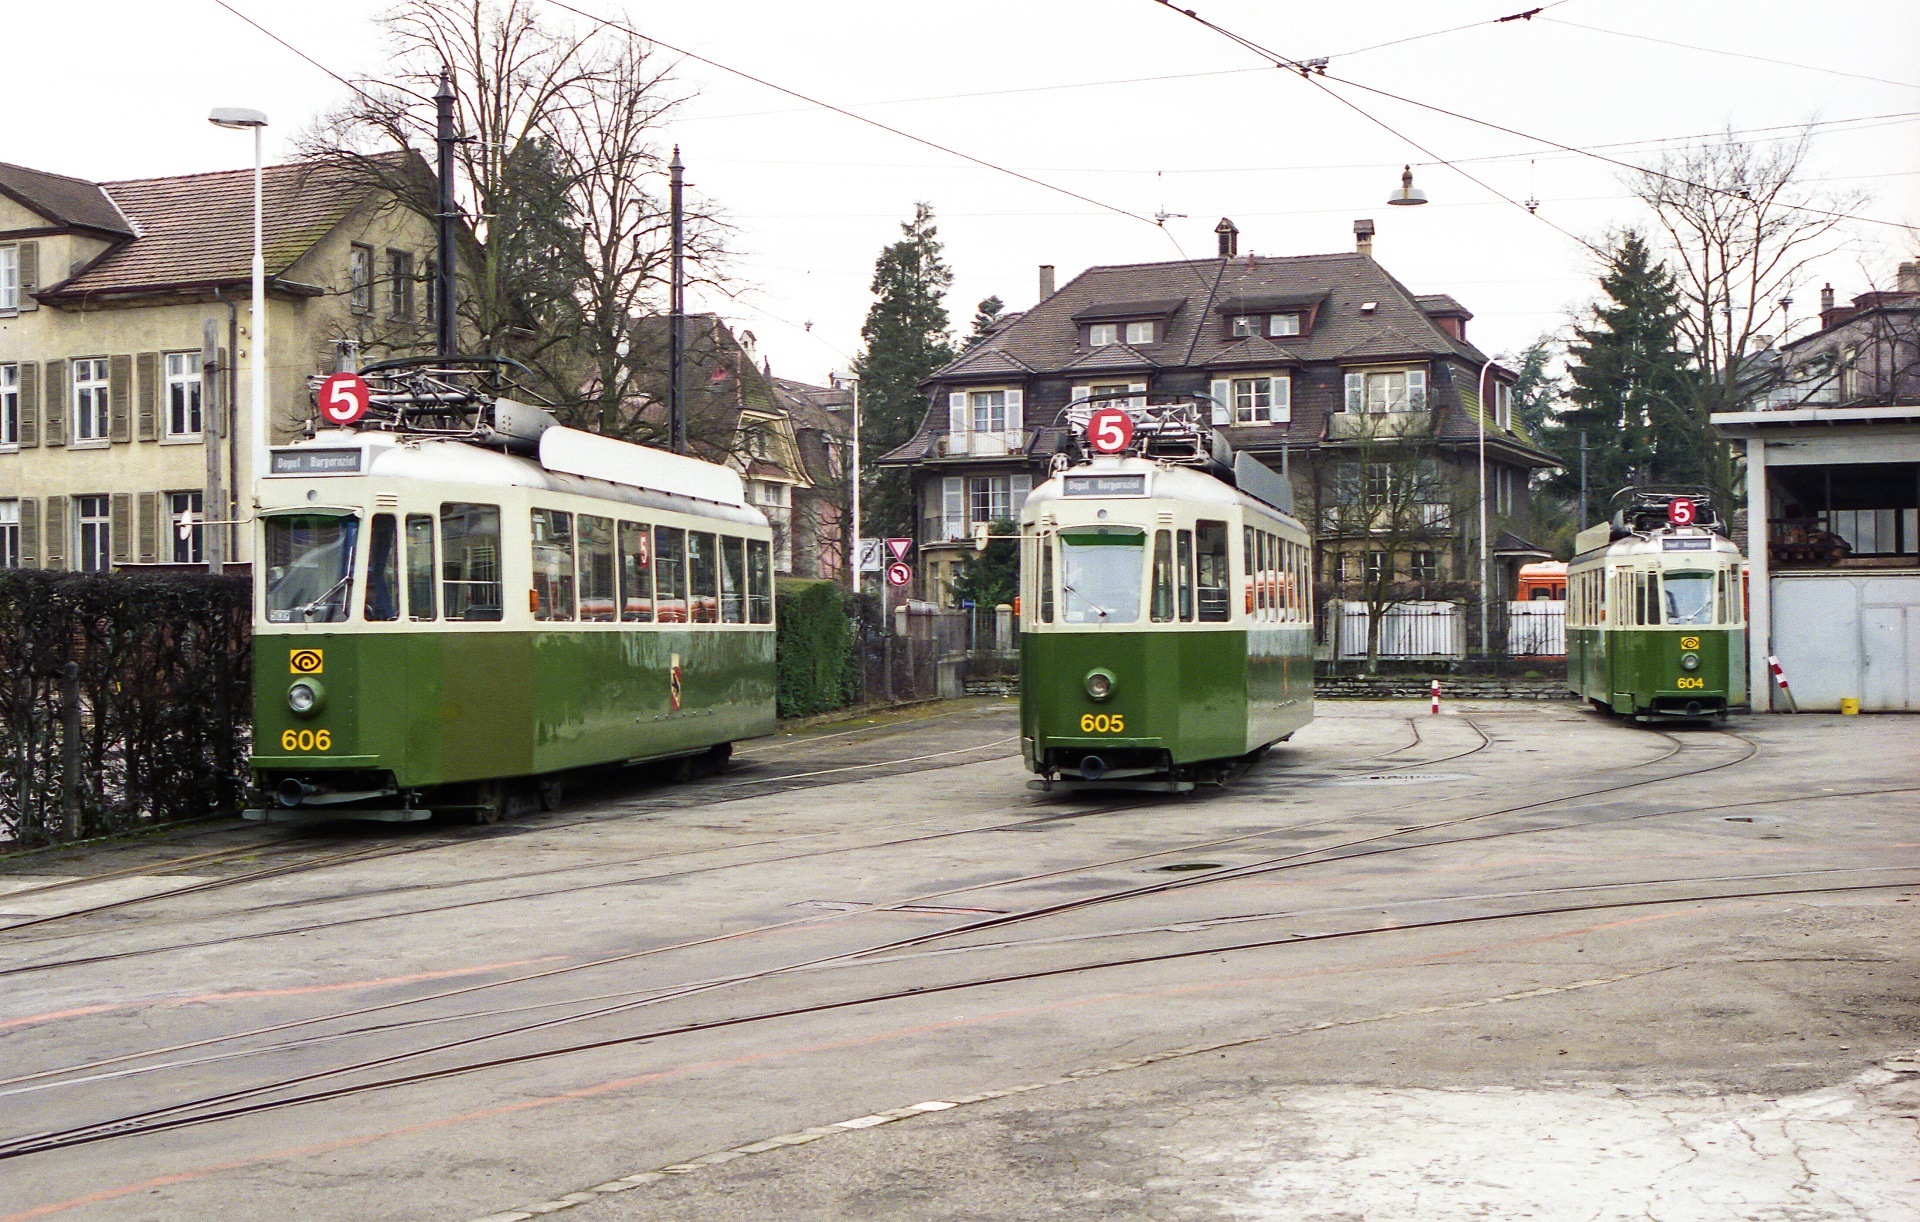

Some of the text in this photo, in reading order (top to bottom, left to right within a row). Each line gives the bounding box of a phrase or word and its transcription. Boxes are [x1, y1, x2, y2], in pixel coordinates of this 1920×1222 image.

[329, 380, 359, 420] 5
[1096, 415, 1124, 450] 5
[277, 457, 301, 470] Depot
[1674, 501, 1690, 523] 5
[1677, 677, 1704, 689] 604
[1080, 713, 1125, 734] 605
[281, 729, 332, 751] 606
